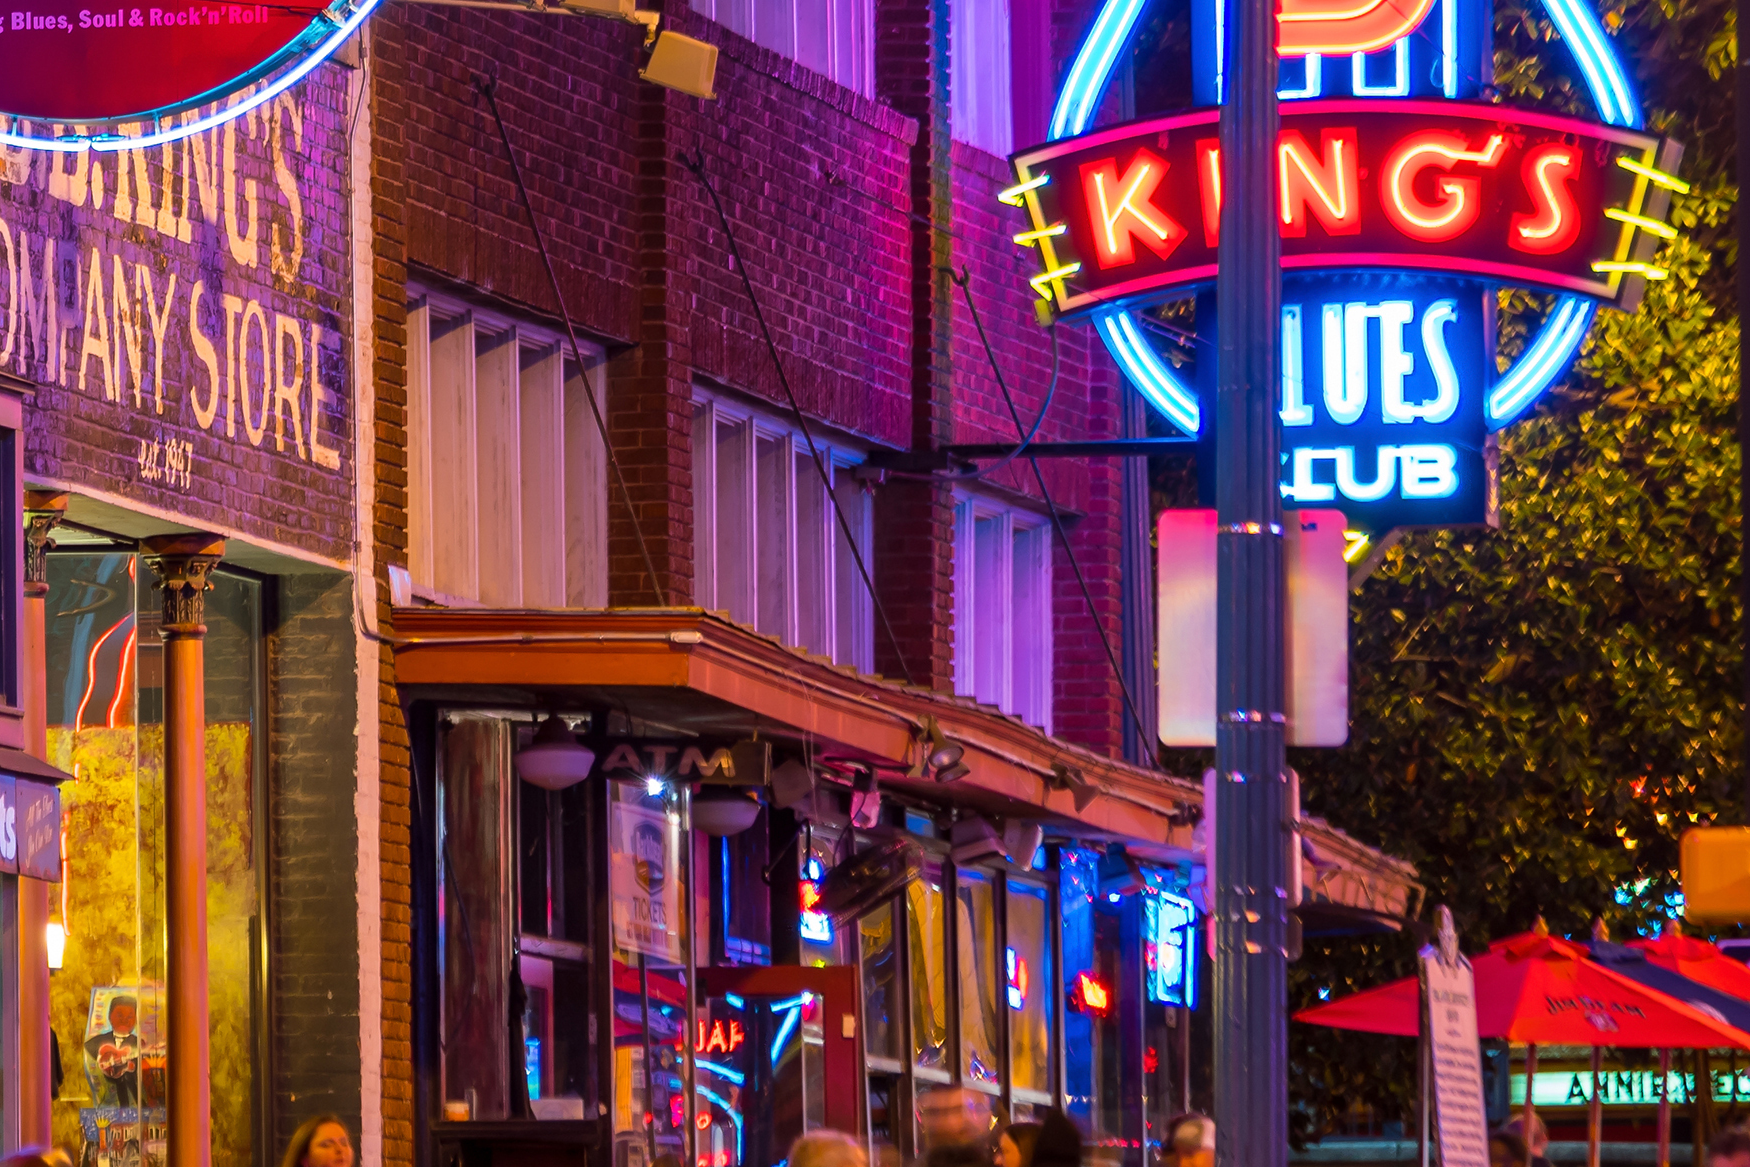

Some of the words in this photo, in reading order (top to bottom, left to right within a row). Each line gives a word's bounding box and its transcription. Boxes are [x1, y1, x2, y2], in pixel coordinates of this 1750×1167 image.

[11, 10, 74, 34] Blues,
[78, 8, 124, 29] Soul
[128, 7, 144, 28] &
[113, 82, 306, 283] KING'S
[1078, 127, 1582, 272] KING'S
[190, 280, 341, 471] STORE
[1279, 298, 1461, 427] LUES
[1280, 444, 1460, 503] LUB
[602, 744, 735, 777] ATM
[633, 896, 667, 925] TICKETS
